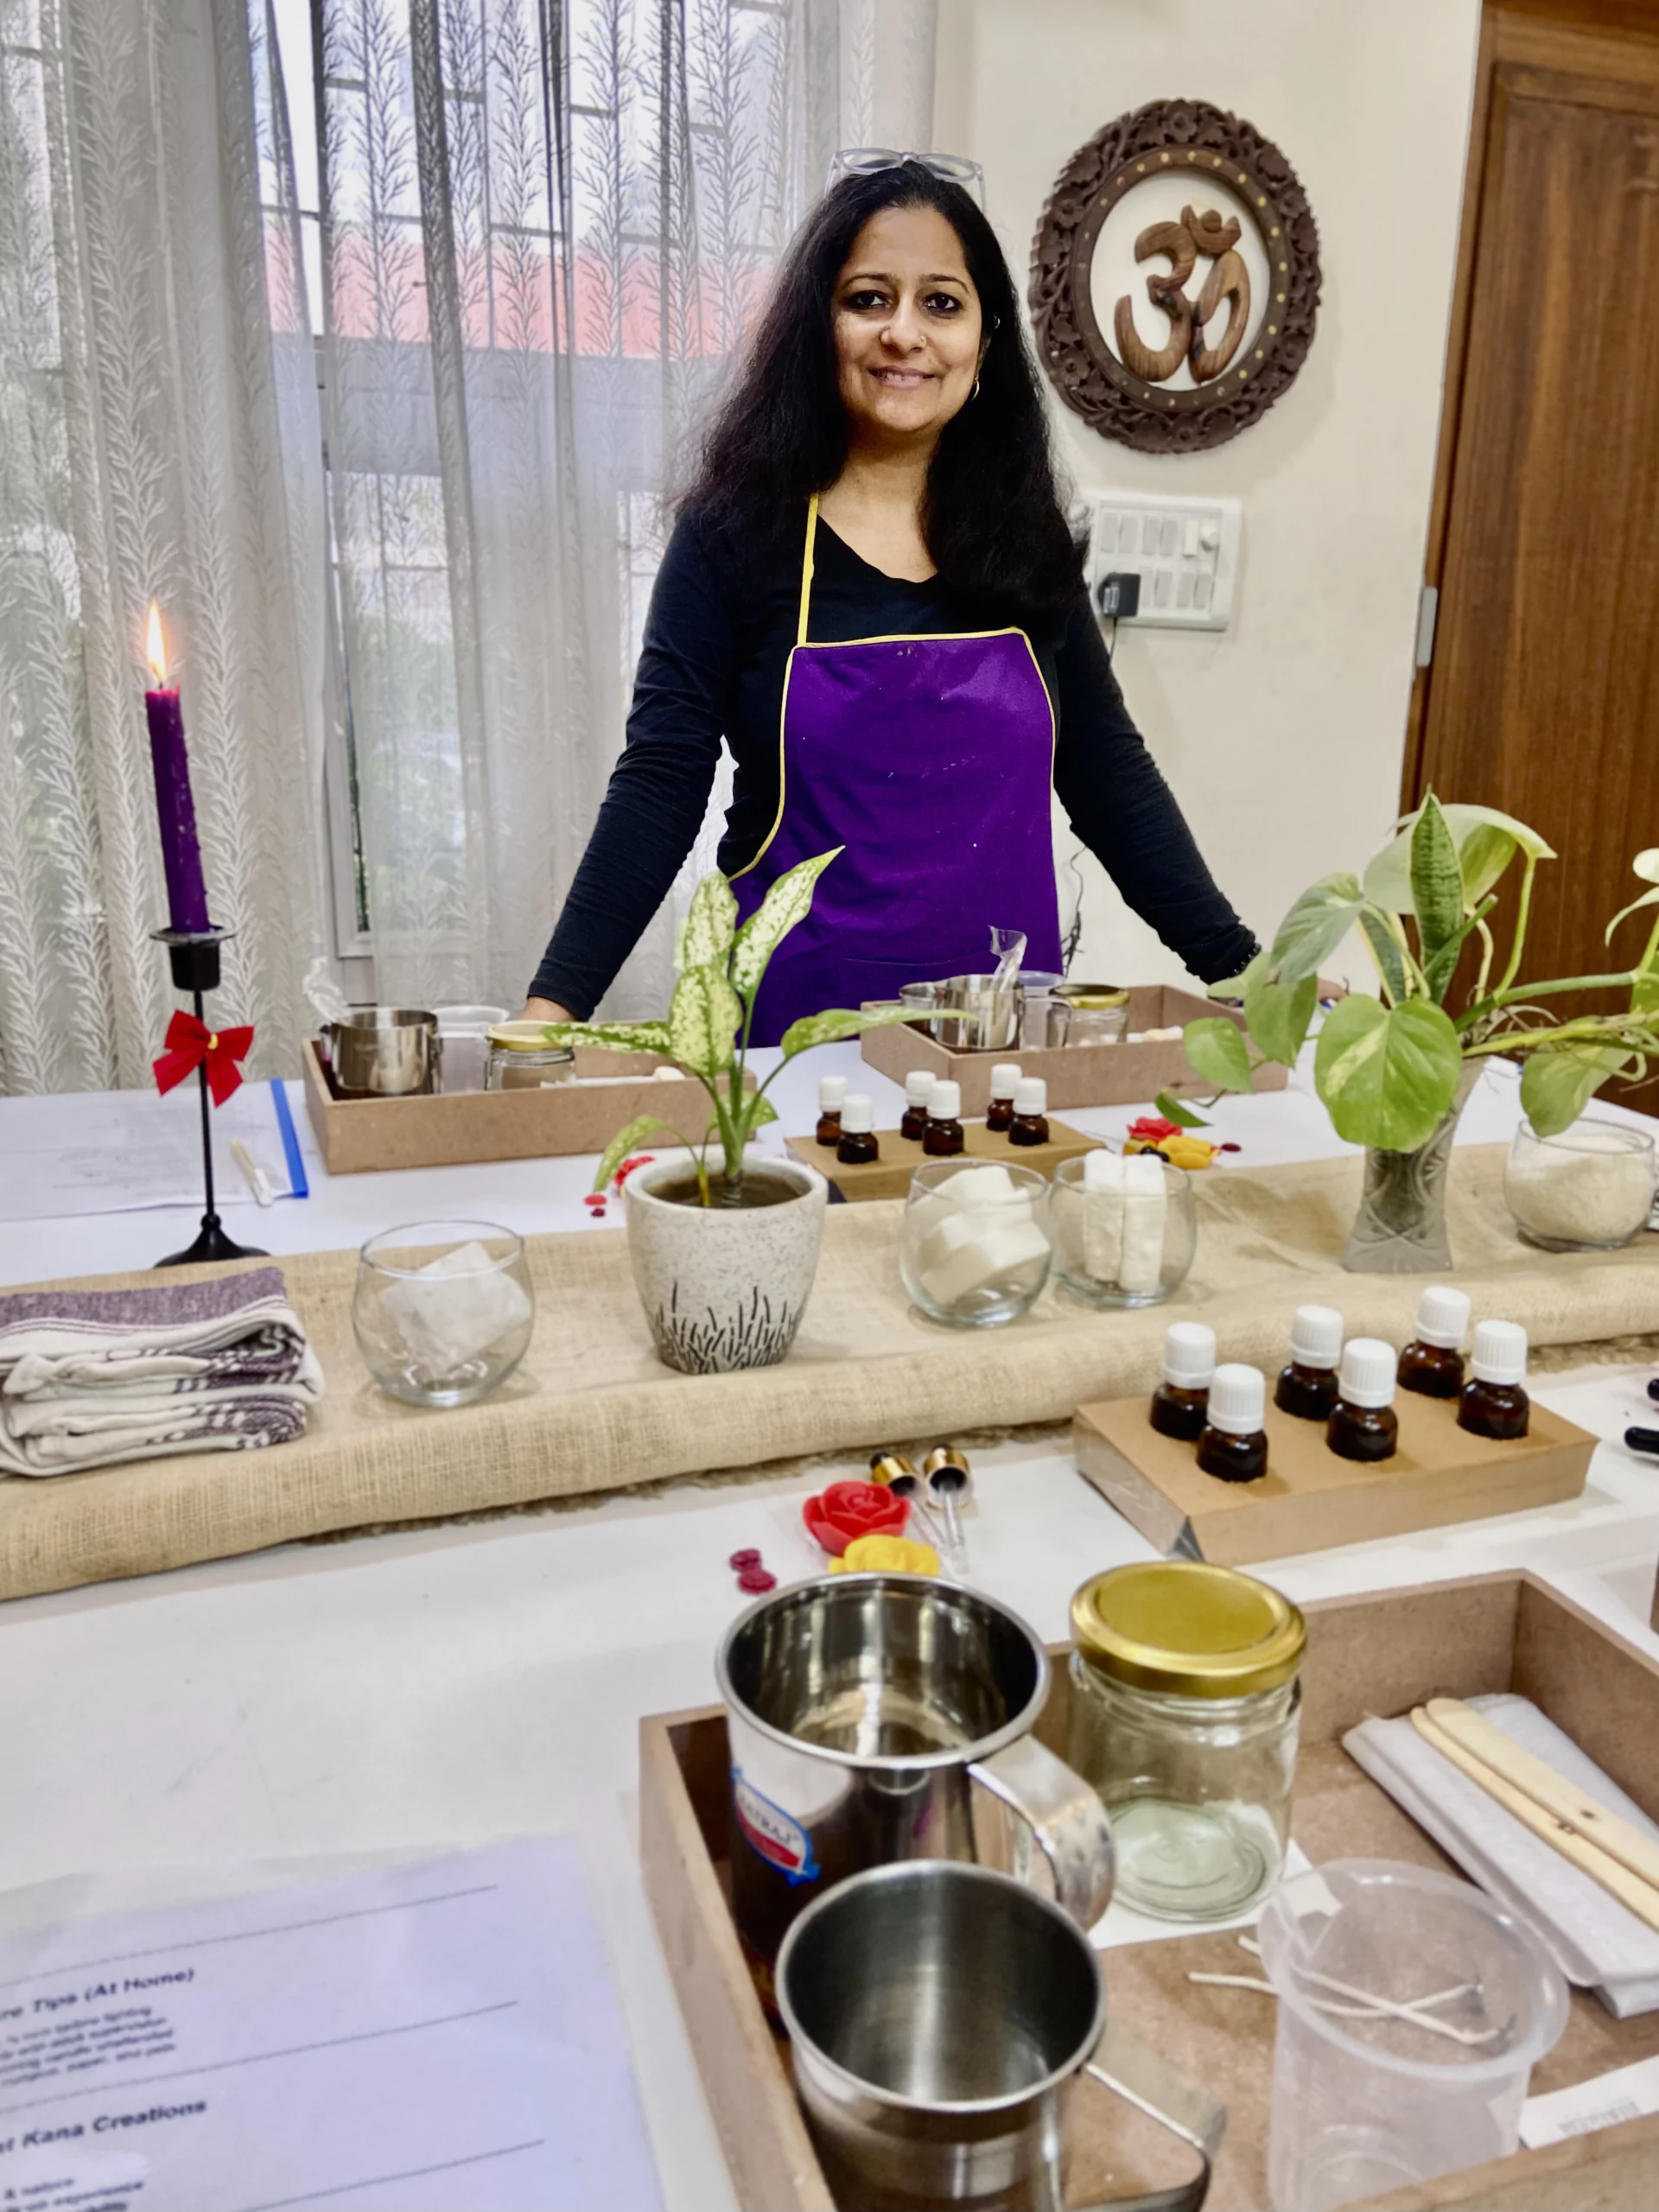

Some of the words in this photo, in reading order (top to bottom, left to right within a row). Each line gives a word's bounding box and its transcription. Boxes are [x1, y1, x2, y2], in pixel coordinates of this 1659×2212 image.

[0, 2006, 24, 2020] re
[34, 1993, 78, 2013] Tips
[84, 1981, 118, 2003] (At
[124, 1967, 195, 1992] Home)
[22, 2124, 85, 2148] Kana
[92, 2100, 207, 2133] Creations
